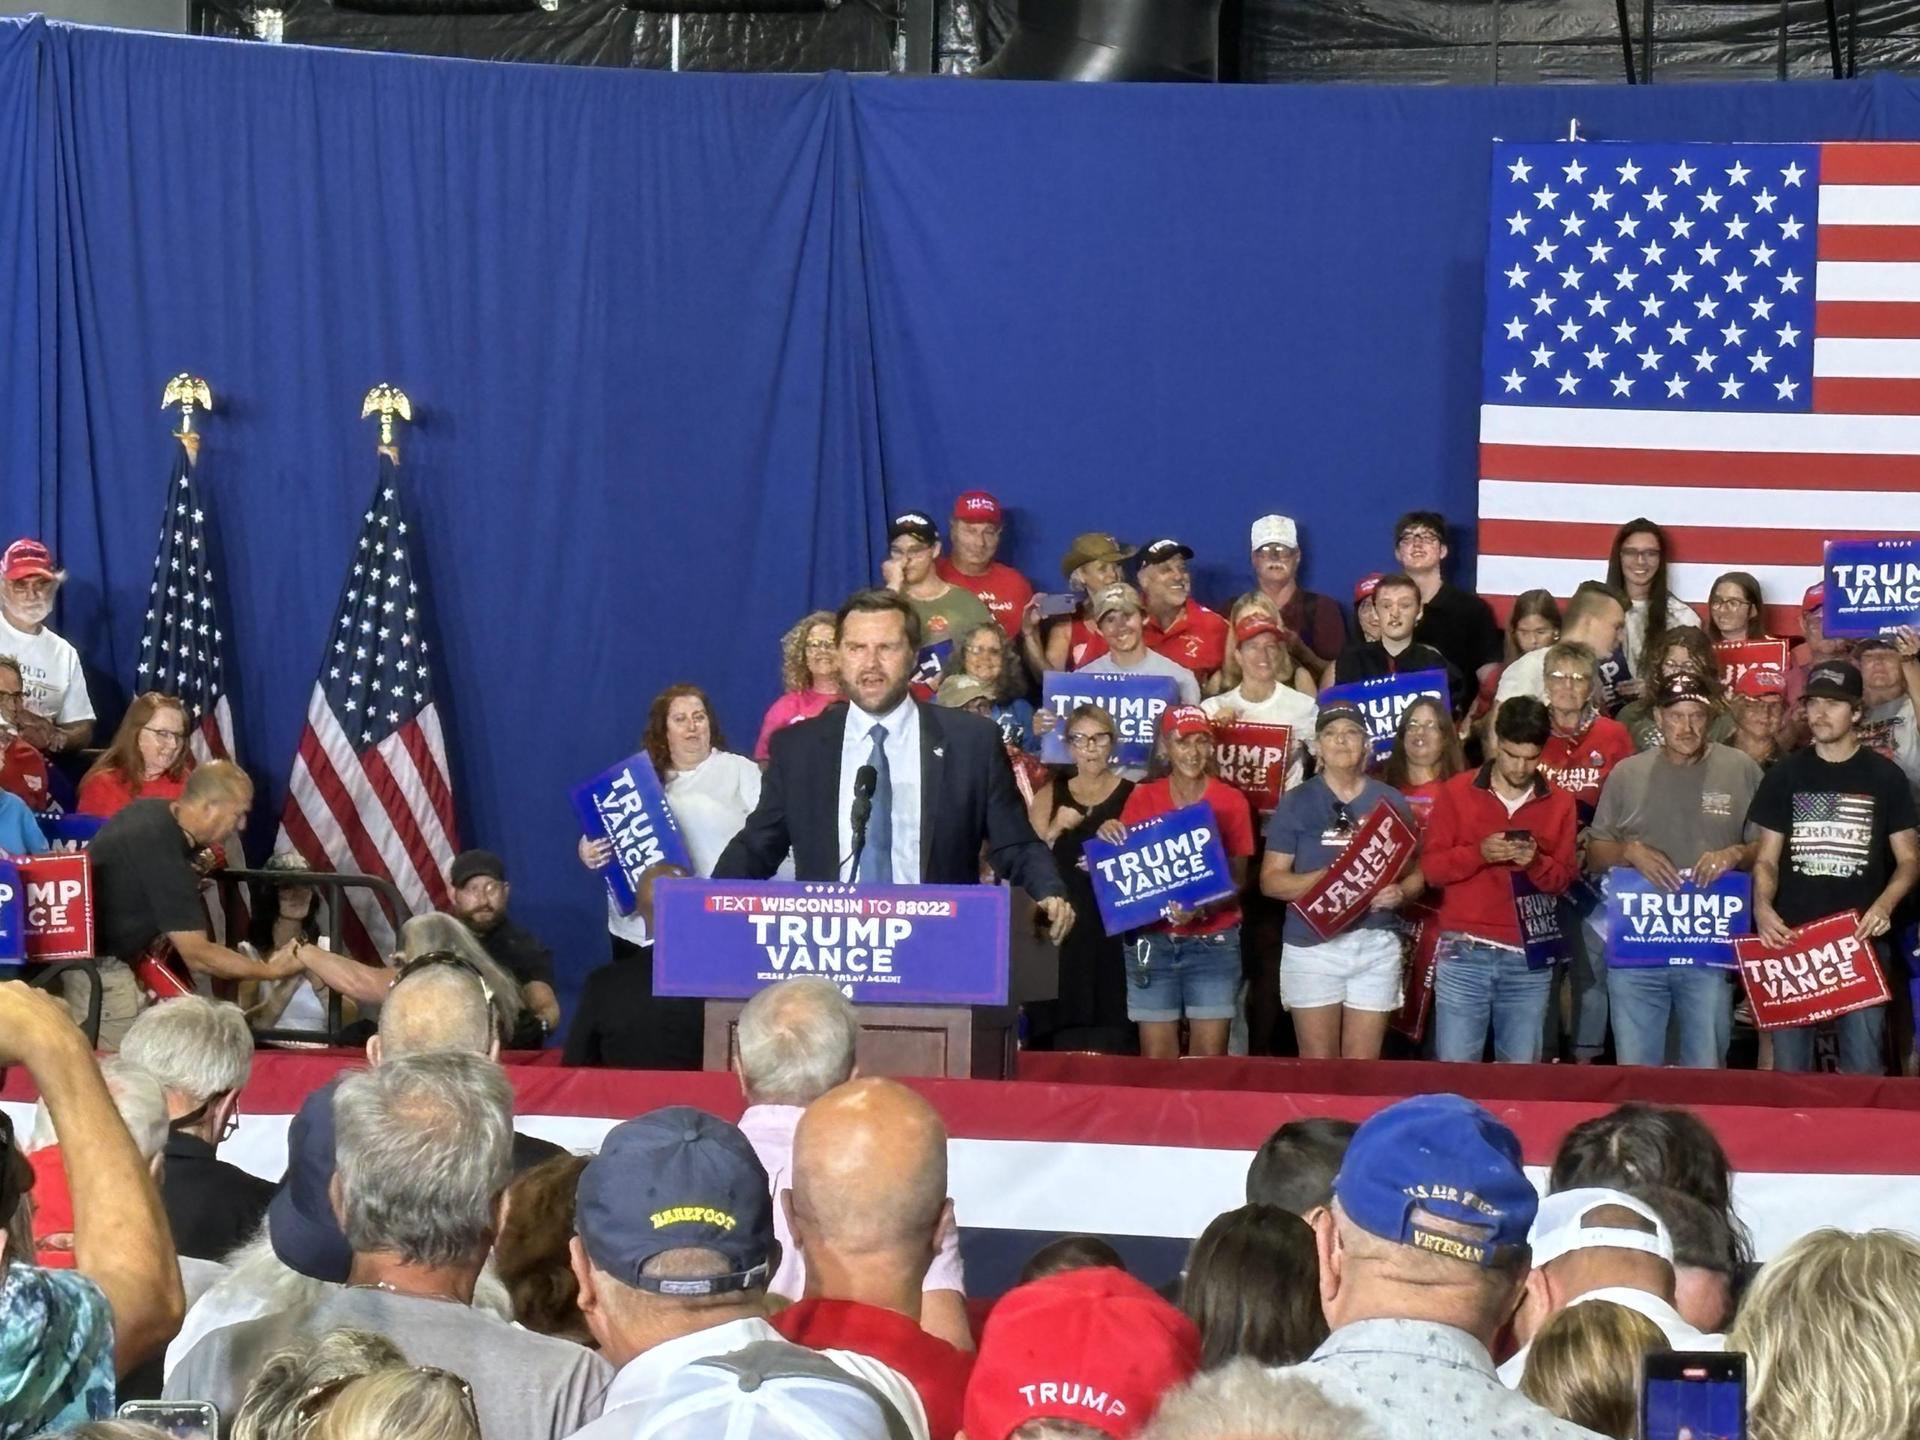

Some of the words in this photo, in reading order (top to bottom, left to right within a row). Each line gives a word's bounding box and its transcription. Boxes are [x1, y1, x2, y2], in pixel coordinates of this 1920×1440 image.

[611, 767, 665, 867] TRUM
[1096, 827, 1212, 882] TRUMP
[1307, 816, 1394, 914] TRUMP
[1115, 852, 1207, 896] VANCE
[711, 896, 757, 912] TEXT
[760, 898, 863, 914] WISCONSIN
[868, 900, 892, 914] TO
[1616, 892, 1744, 918] TRUMP
[748, 915, 913, 948] TRUMP
[1631, 916, 1730, 937] VANCE
[765, 946, 893, 973] VANCE
[1744, 935, 1861, 983] TRUMP
[1762, 960, 1858, 999] VANCE
[649, 1206, 737, 1231] BAREFOOT
[1414, 1230, 1485, 1262] VETERAN
[1018, 1381, 1127, 1417] TRUMP
